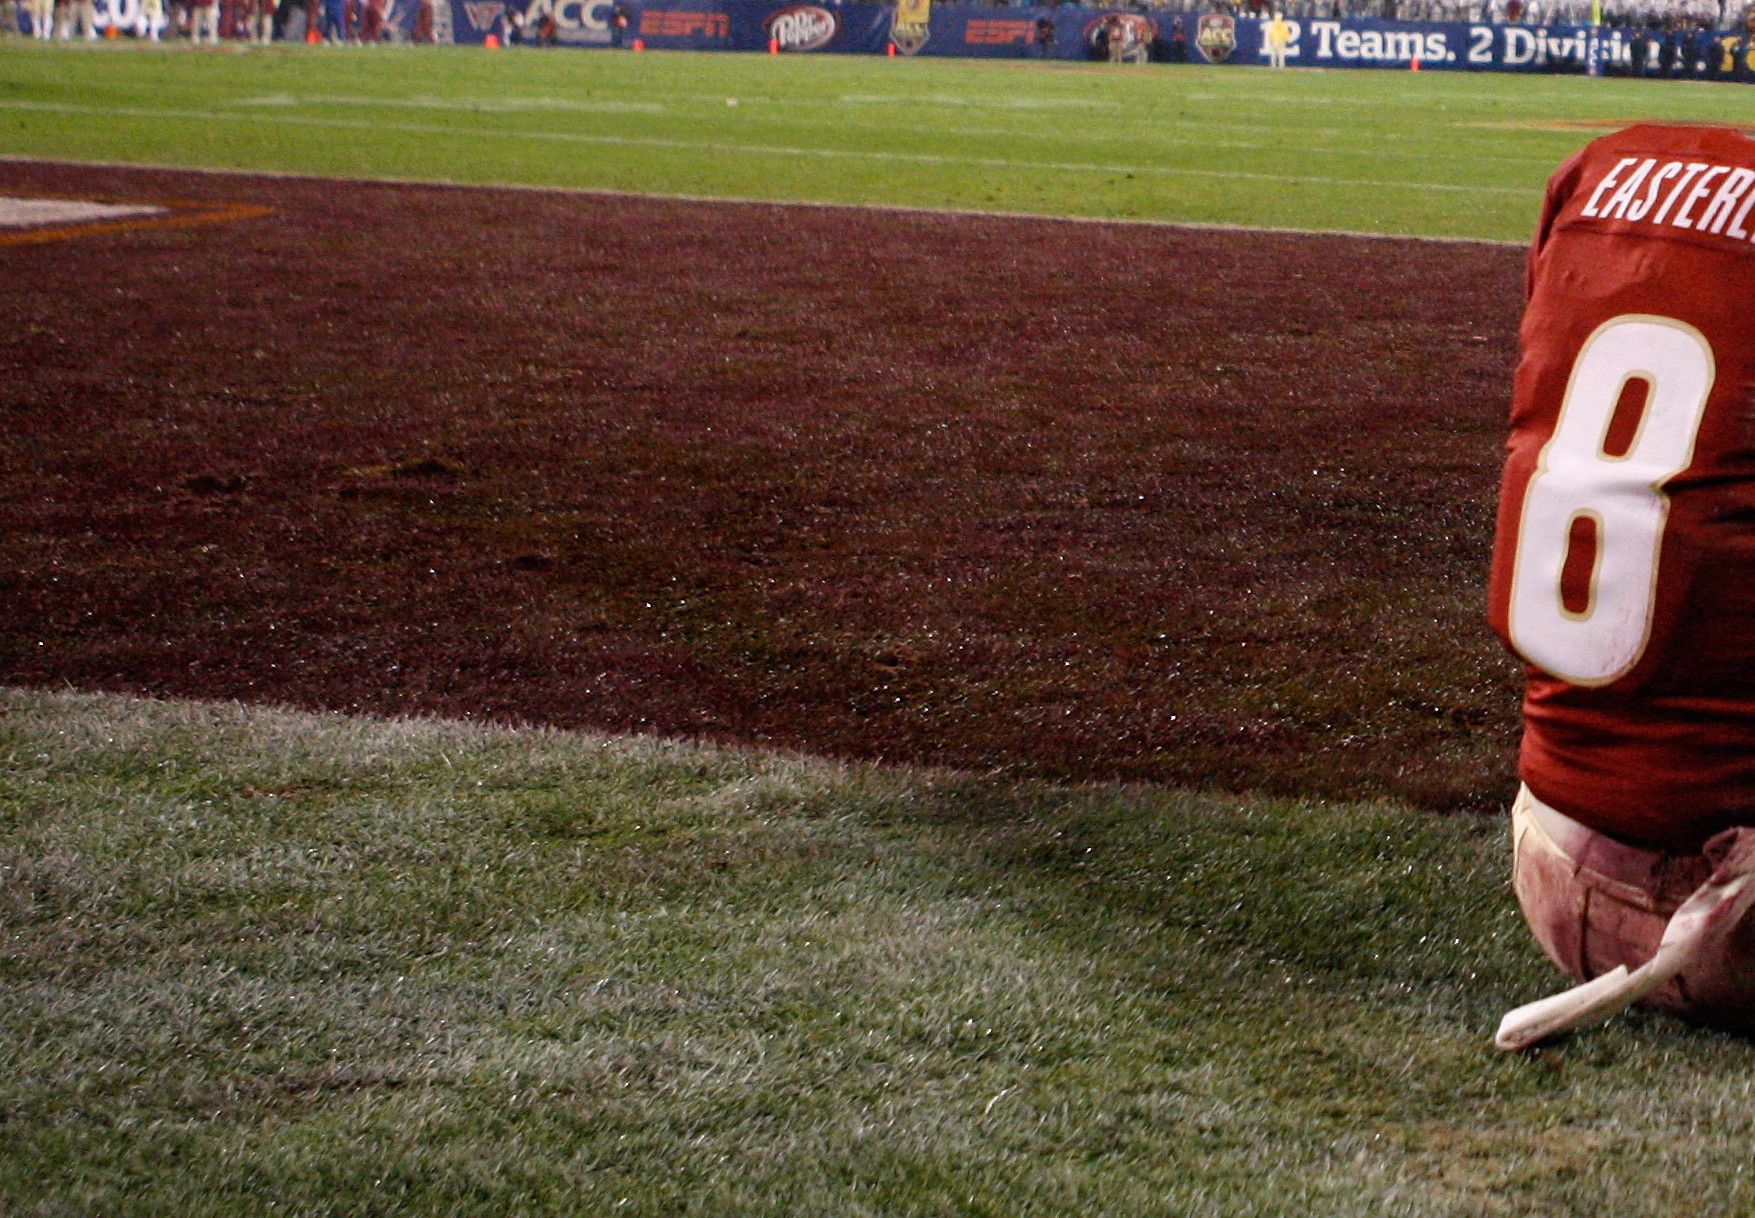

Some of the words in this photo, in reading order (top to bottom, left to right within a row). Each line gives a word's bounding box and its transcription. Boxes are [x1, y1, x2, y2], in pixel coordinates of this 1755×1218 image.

[1311, 21, 1457, 62] Teams.
[1469, 26, 1495, 64] 2
[1507, 312, 1717, 688] 8
